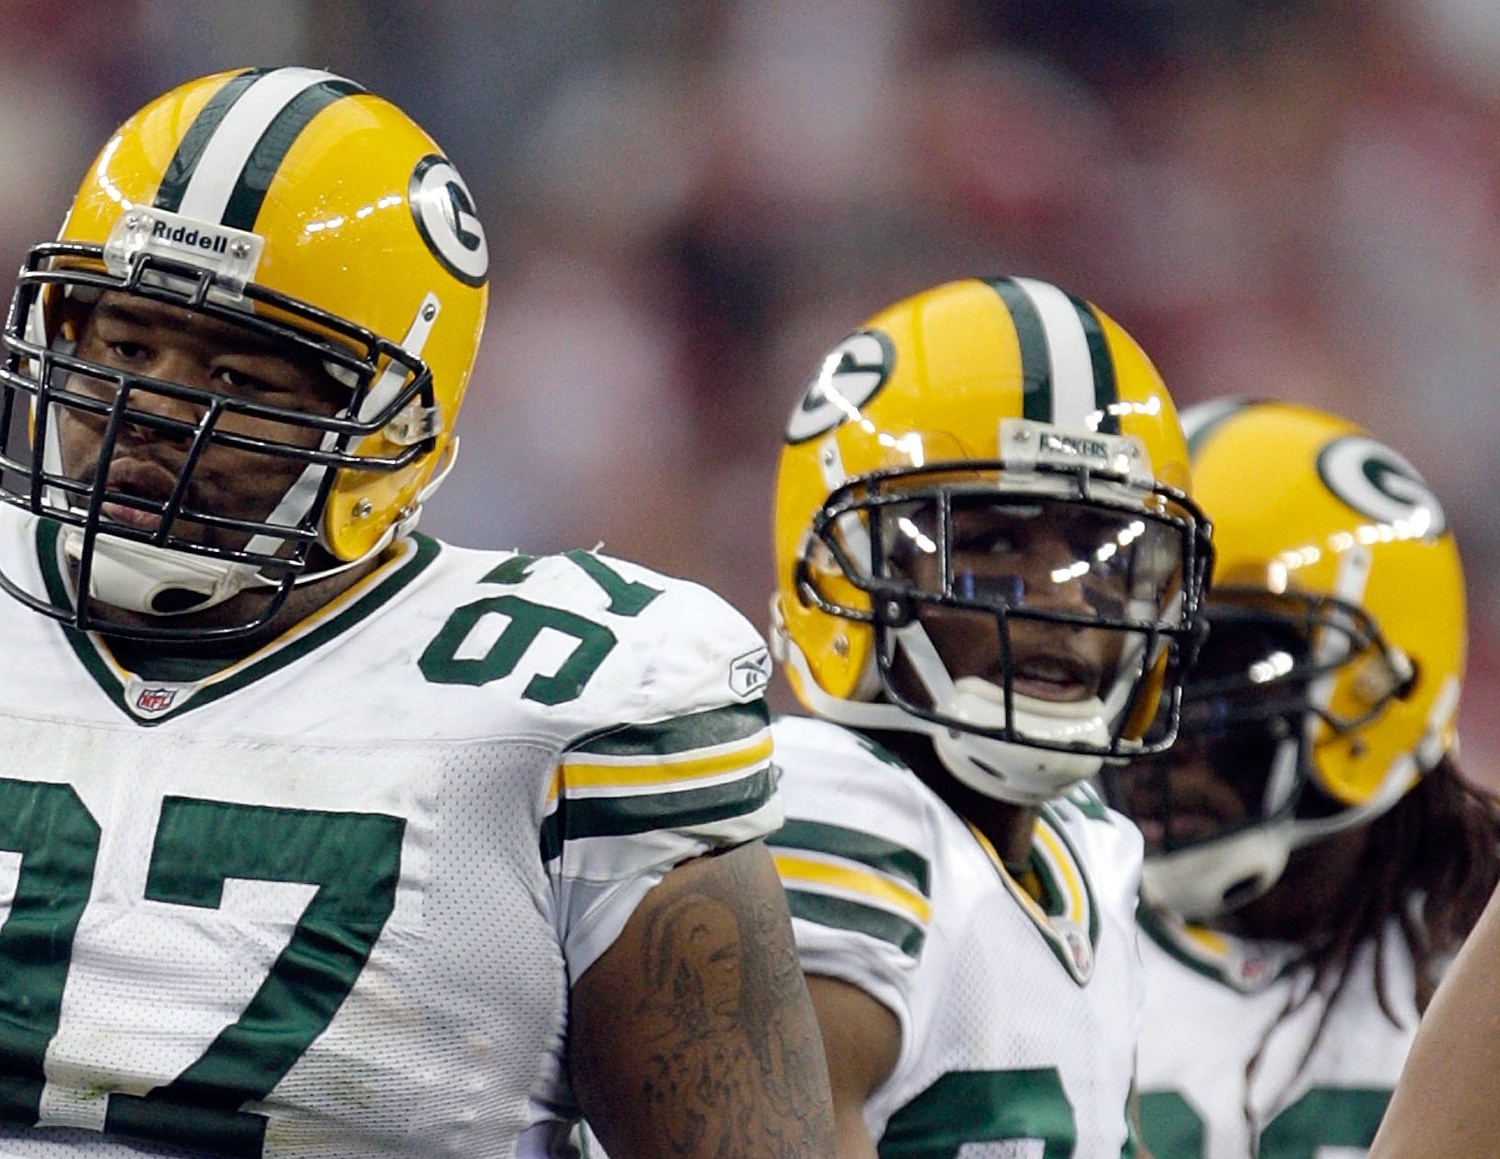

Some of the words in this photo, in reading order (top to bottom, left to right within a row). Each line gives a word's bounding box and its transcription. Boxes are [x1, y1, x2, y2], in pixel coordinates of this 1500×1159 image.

[152, 220, 229, 254] Riddell
[1040, 432, 1109, 459] PCKERS
[417, 547, 666, 706] 97
